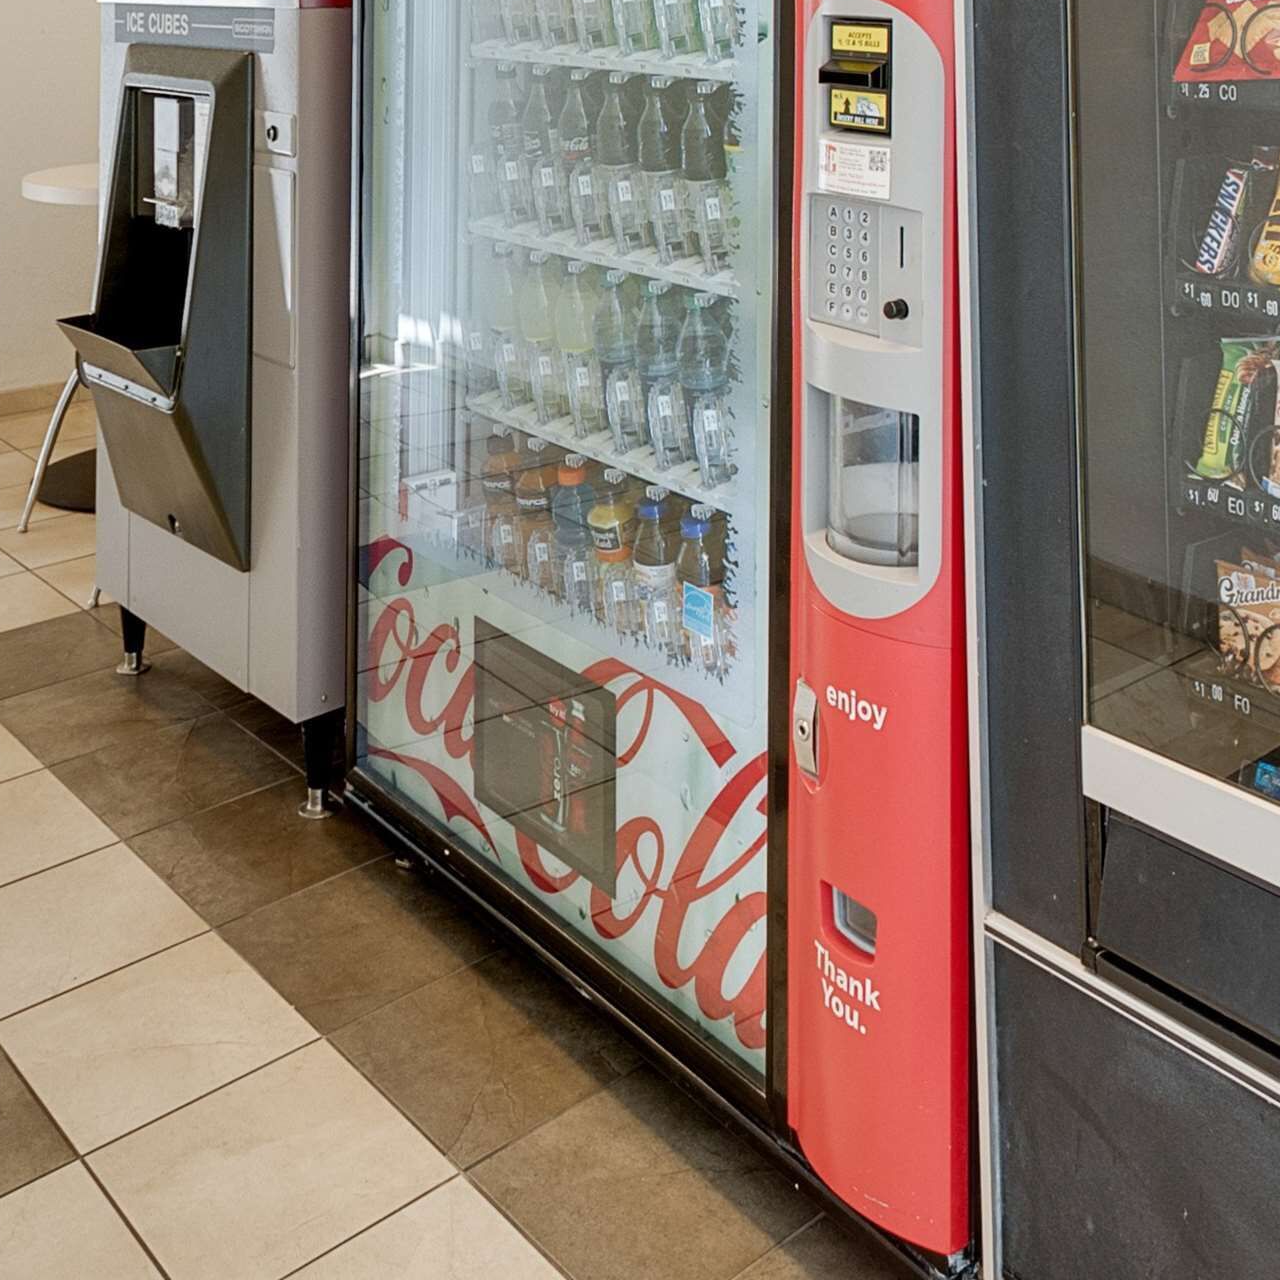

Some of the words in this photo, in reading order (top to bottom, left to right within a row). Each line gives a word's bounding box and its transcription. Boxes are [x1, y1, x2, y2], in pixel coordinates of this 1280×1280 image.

[127, 12, 144, 33] ICE
[148, 13, 189, 35] CUBES
[1220, 84, 1237, 101] C0
[1222, 290, 1240, 308] D0
[1228, 497, 1244, 516] E0
[825, 684, 888, 732] enjoy
[1234, 695, 1250, 714] F0
[814, 940, 881, 1011] Thank
[821, 979, 867, 1035] You.
